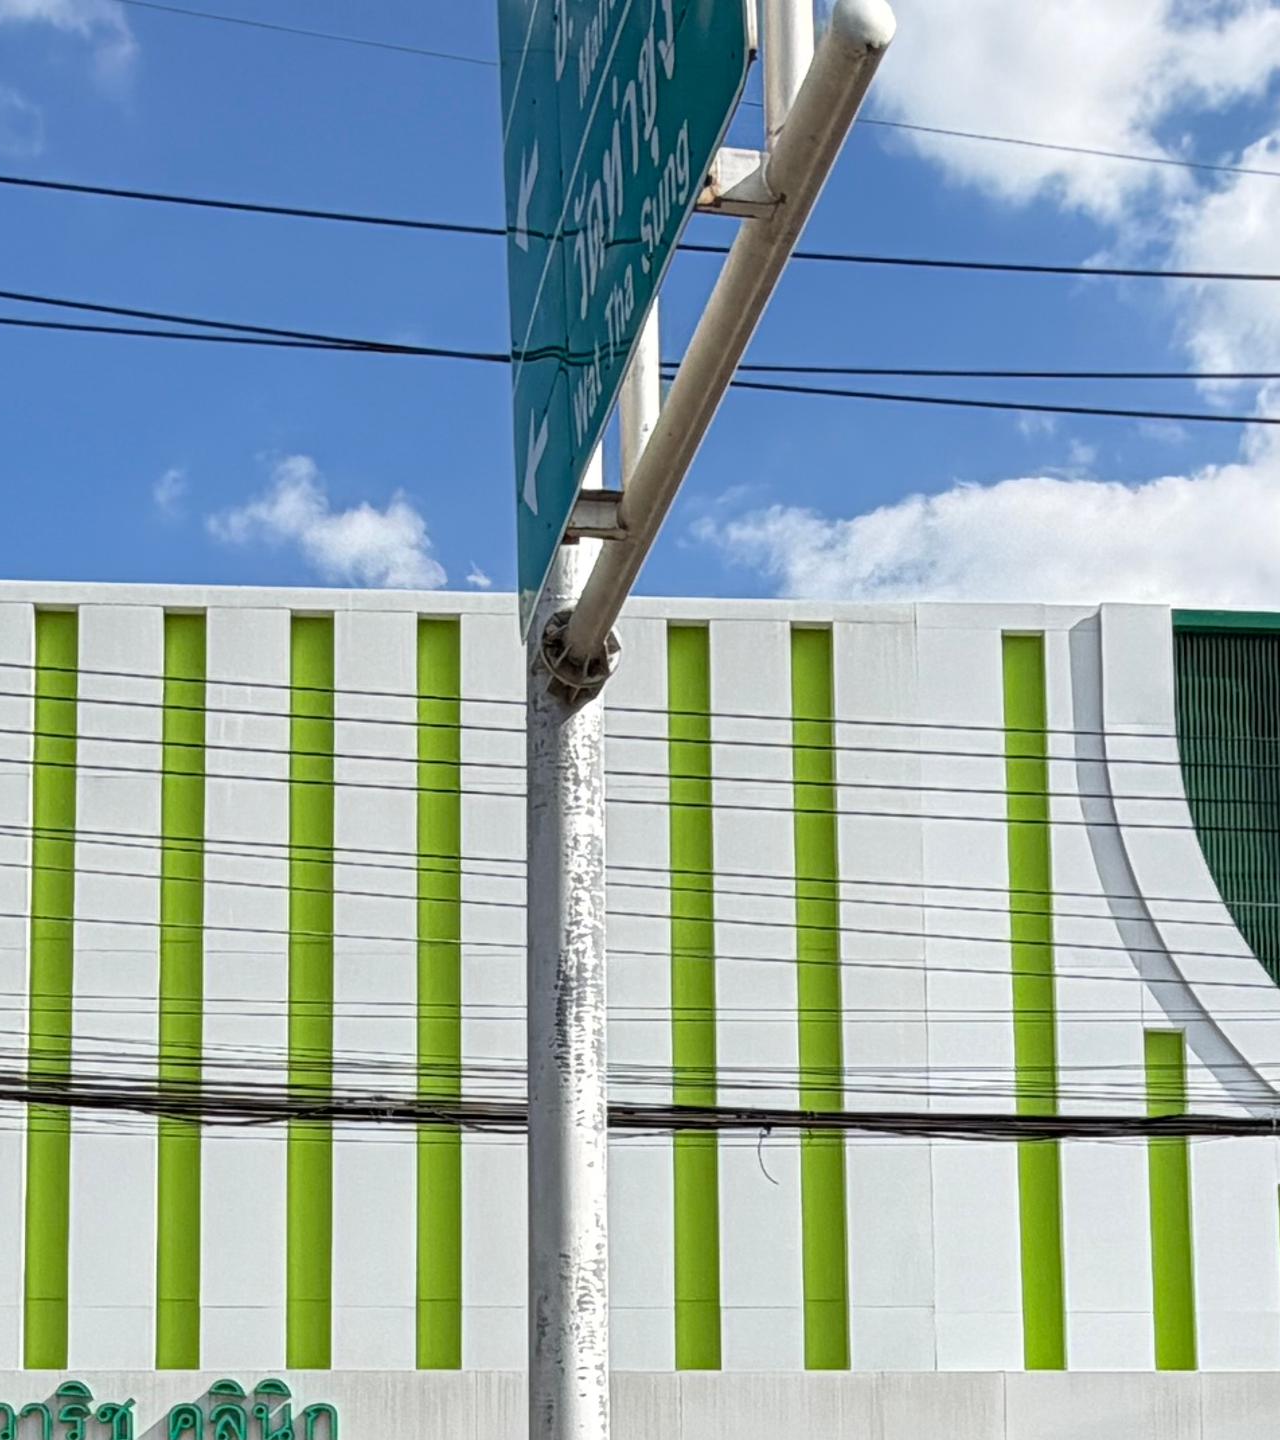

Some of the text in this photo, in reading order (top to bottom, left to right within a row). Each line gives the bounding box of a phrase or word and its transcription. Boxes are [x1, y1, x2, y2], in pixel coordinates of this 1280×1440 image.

[573, 117, 690, 447] Wat Tha Sung
